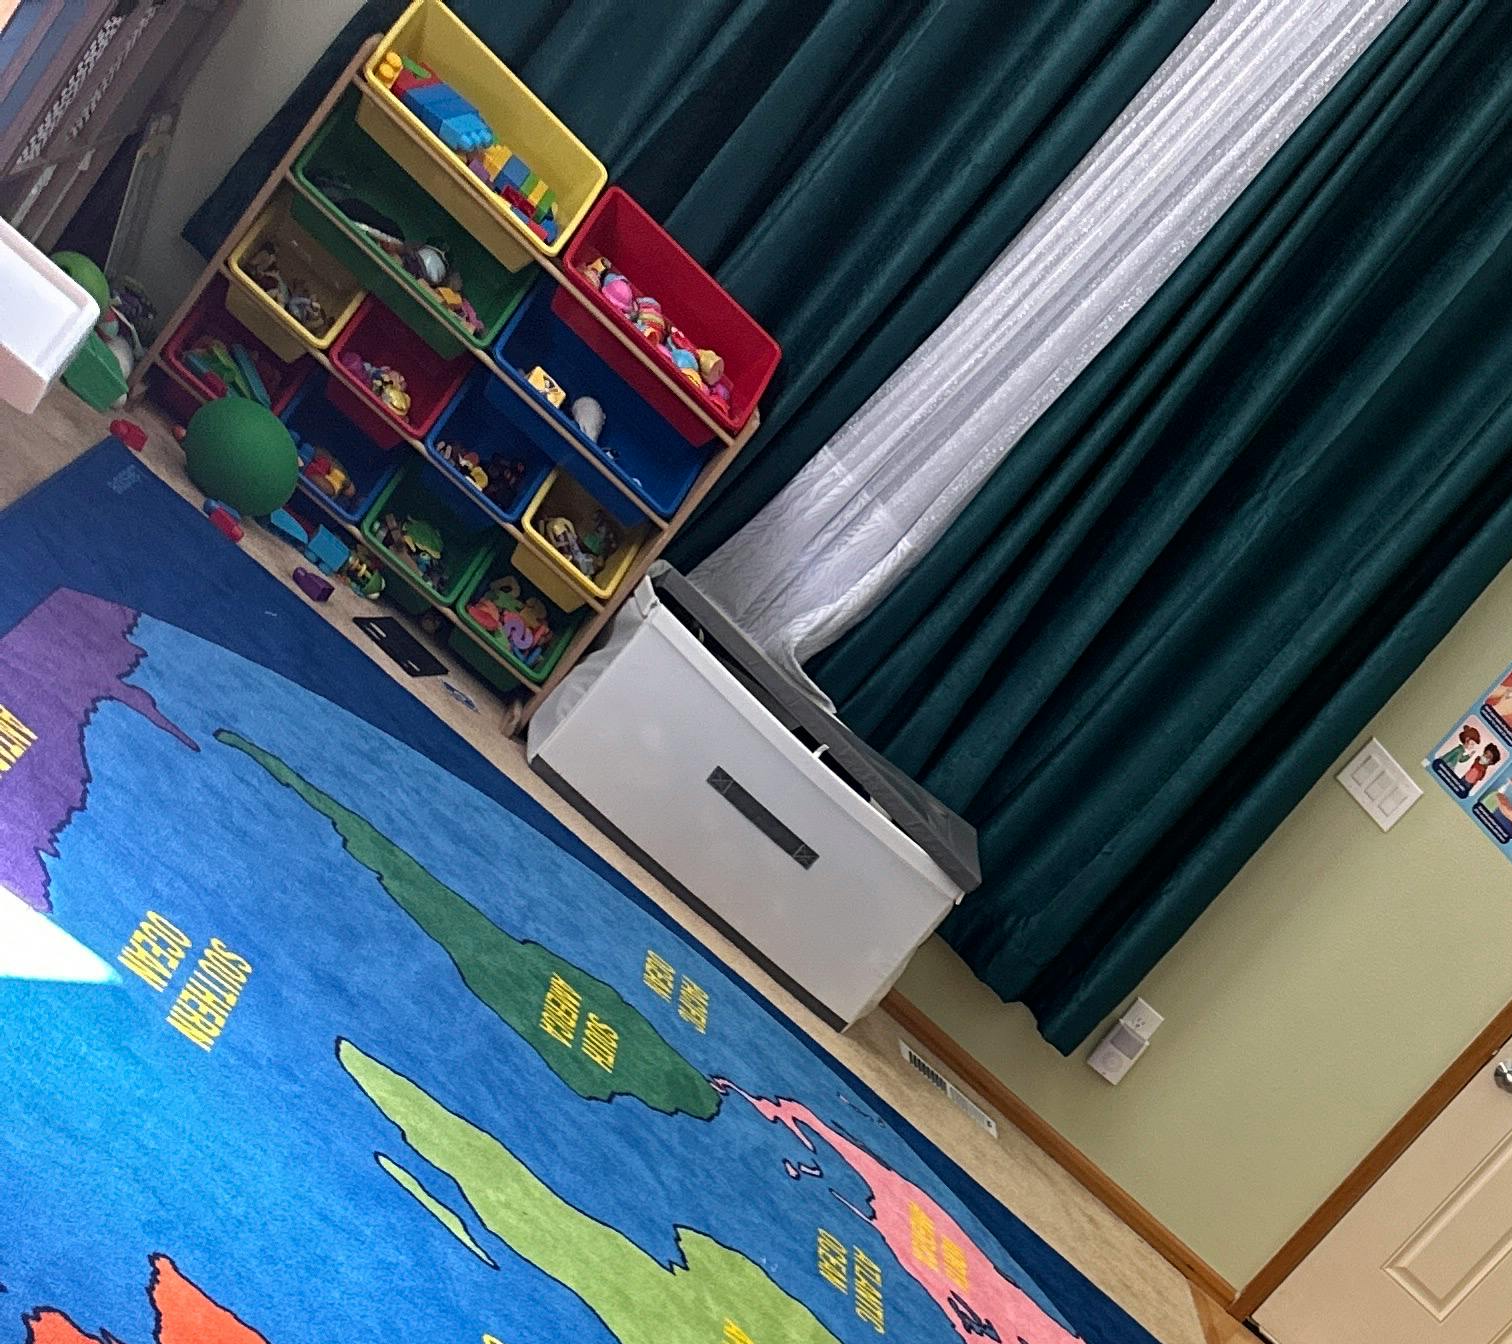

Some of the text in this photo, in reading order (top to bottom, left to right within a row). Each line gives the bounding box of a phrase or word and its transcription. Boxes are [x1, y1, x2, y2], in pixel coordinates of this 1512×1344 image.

[119, 910, 192, 992] OCEAN
[644, 950, 675, 1002] OCEAN
[166, 938, 253, 1052] SOUTHERN
[540, 972, 581, 1048] AMERICA
[678, 974, 709, 1034] PACIFIC
[581, 1012, 619, 1073] SOUTH
[817, 1228, 848, 1295] OCEAN
[854, 1245, 885, 1335] ATLANTIC
